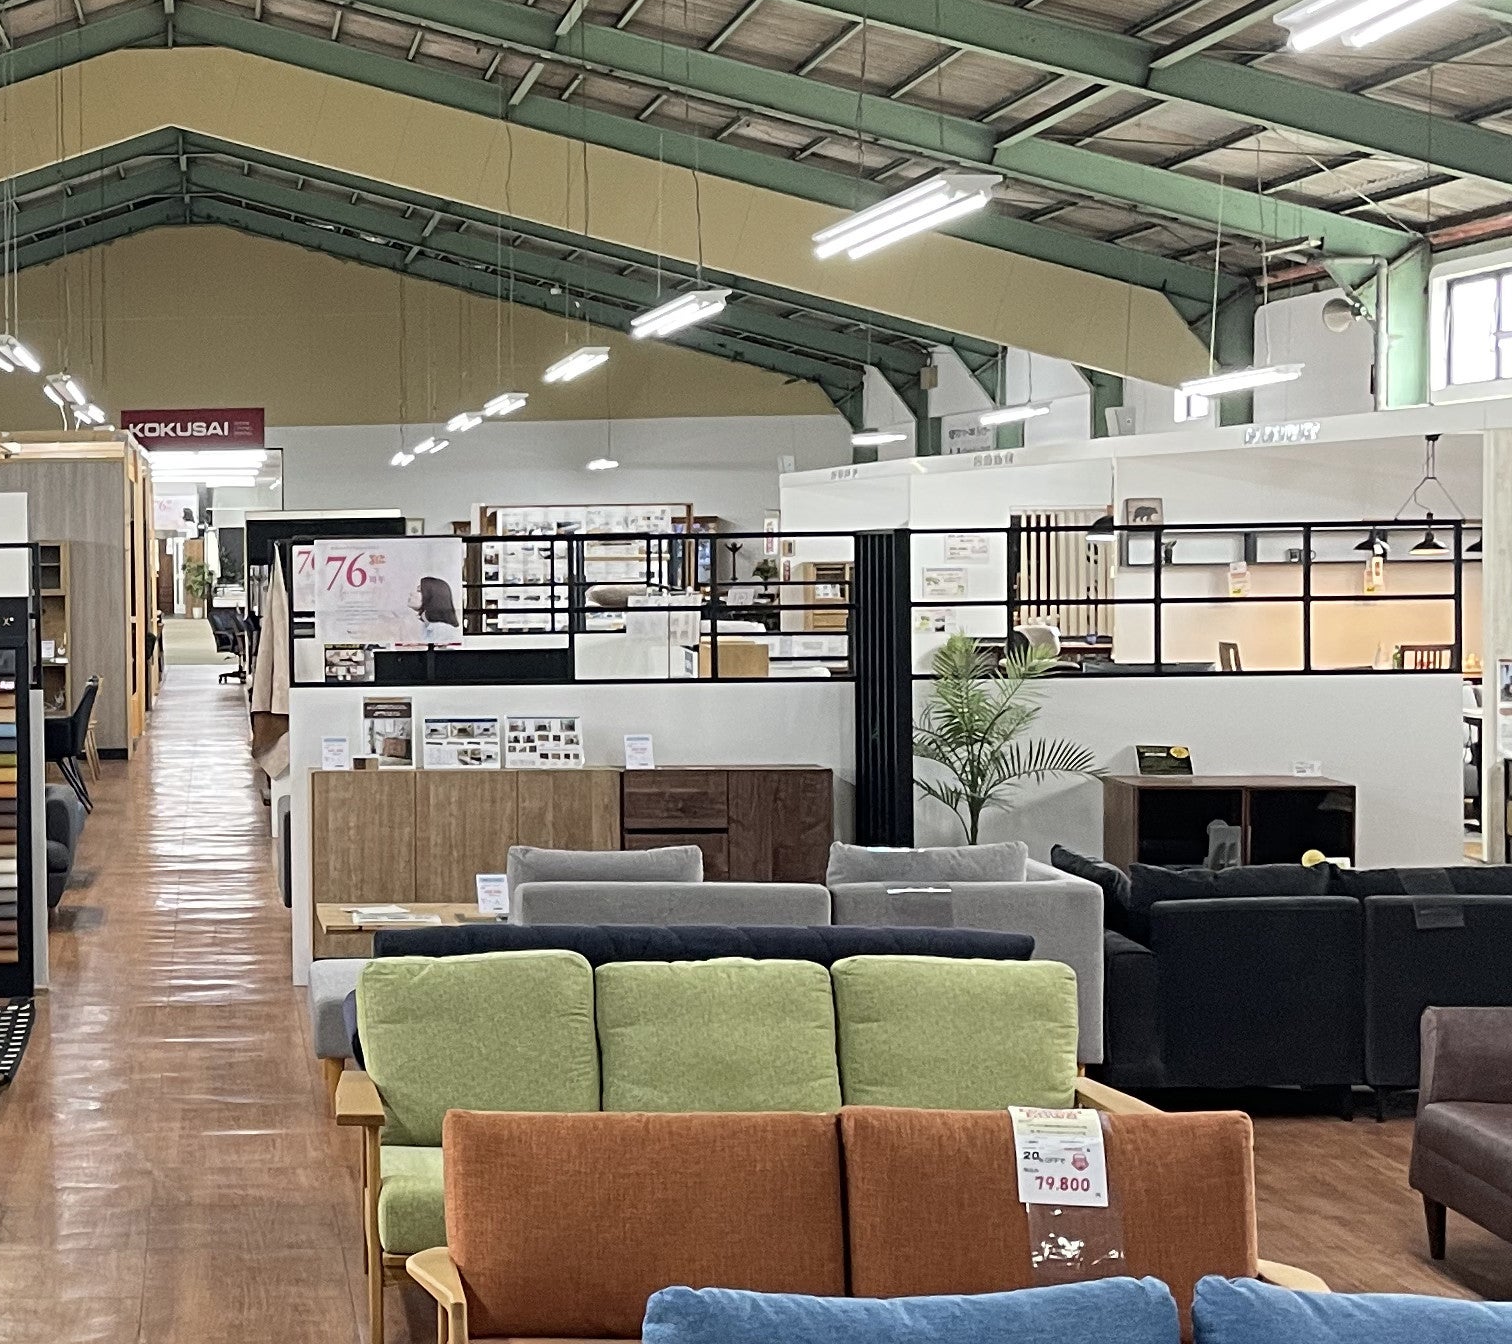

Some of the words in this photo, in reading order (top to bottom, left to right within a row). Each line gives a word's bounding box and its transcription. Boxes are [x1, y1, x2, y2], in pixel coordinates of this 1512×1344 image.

[129, 420, 229, 438] KOKUSAI
[297, 550, 315, 575] 7
[325, 551, 367, 592] 76
